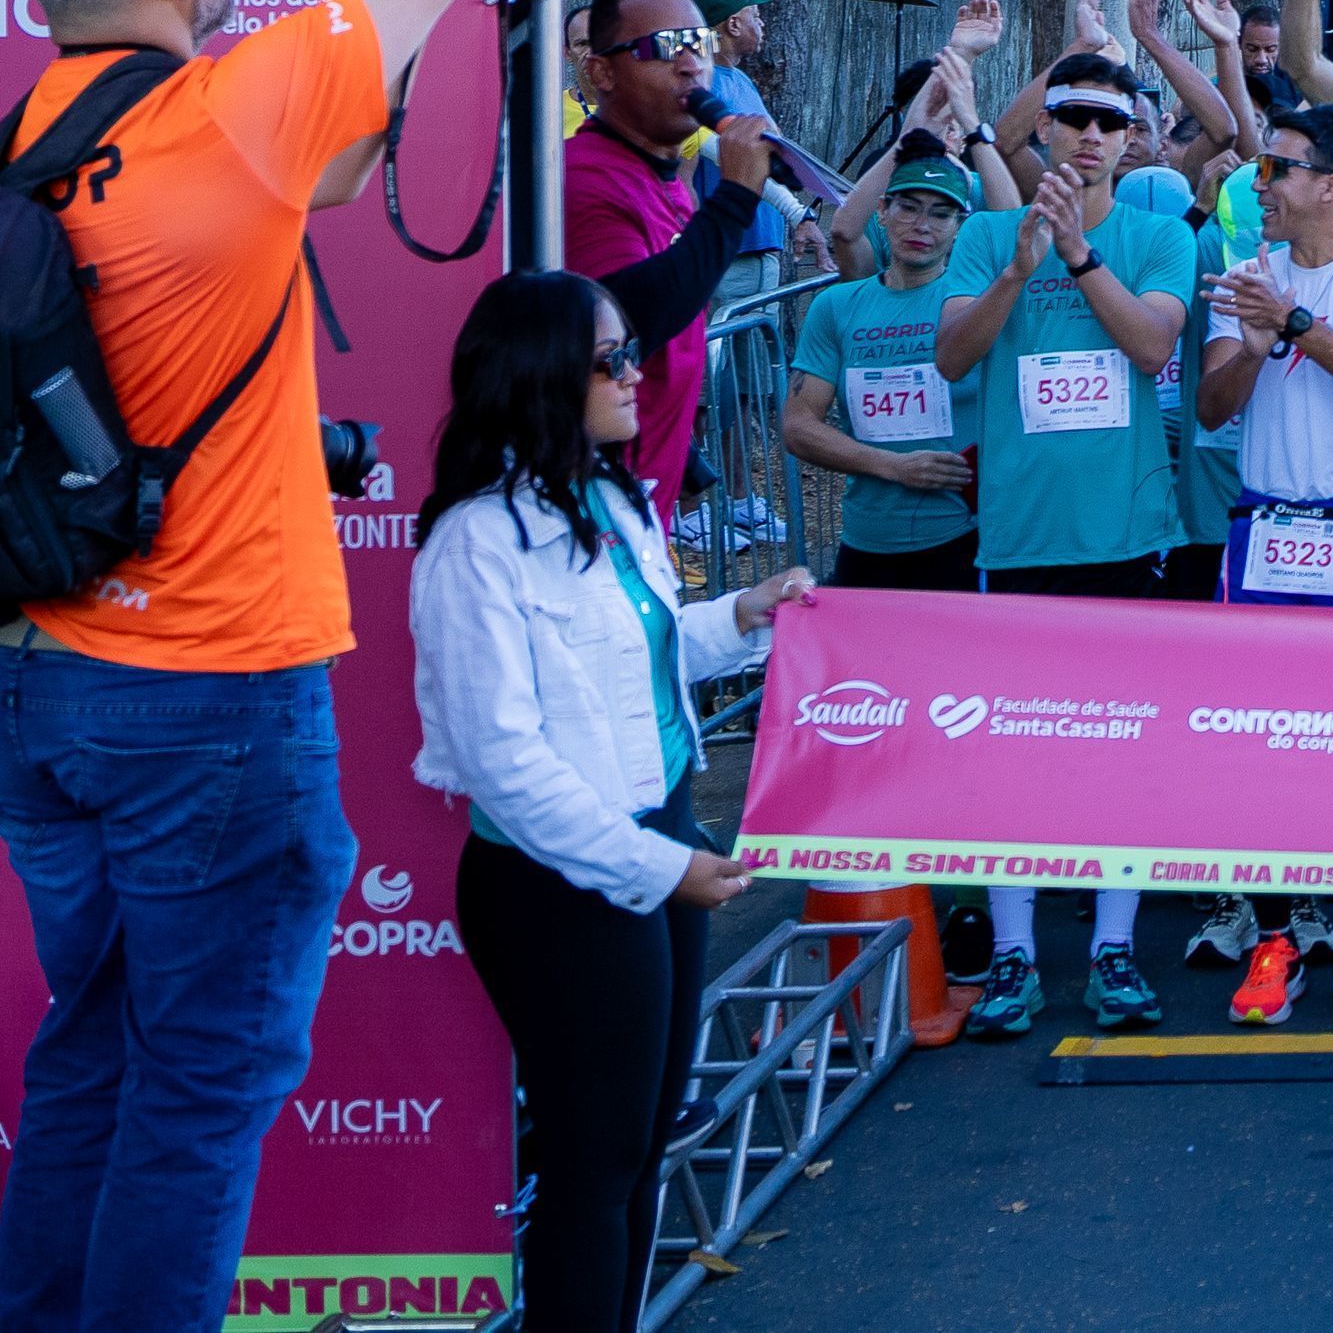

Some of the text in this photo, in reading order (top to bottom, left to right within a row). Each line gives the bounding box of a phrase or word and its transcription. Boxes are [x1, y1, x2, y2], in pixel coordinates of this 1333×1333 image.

[862, 389, 926, 418] 5471
[1037, 376, 1109, 405] 5322
[1264, 538, 1333, 567] 5323
[794, 692, 910, 727] Saudali
[992, 695, 1161, 719] Faculdade de Saúde
[1267, 733, 1296, 750] do
[789, 848, 891, 872] NOSSA
[905, 852, 1104, 878] SINTONIA
[1149, 860, 1220, 883] CORRA
[1231, 863, 1272, 884] NA
[294, 1097, 443, 1134] VICHY
